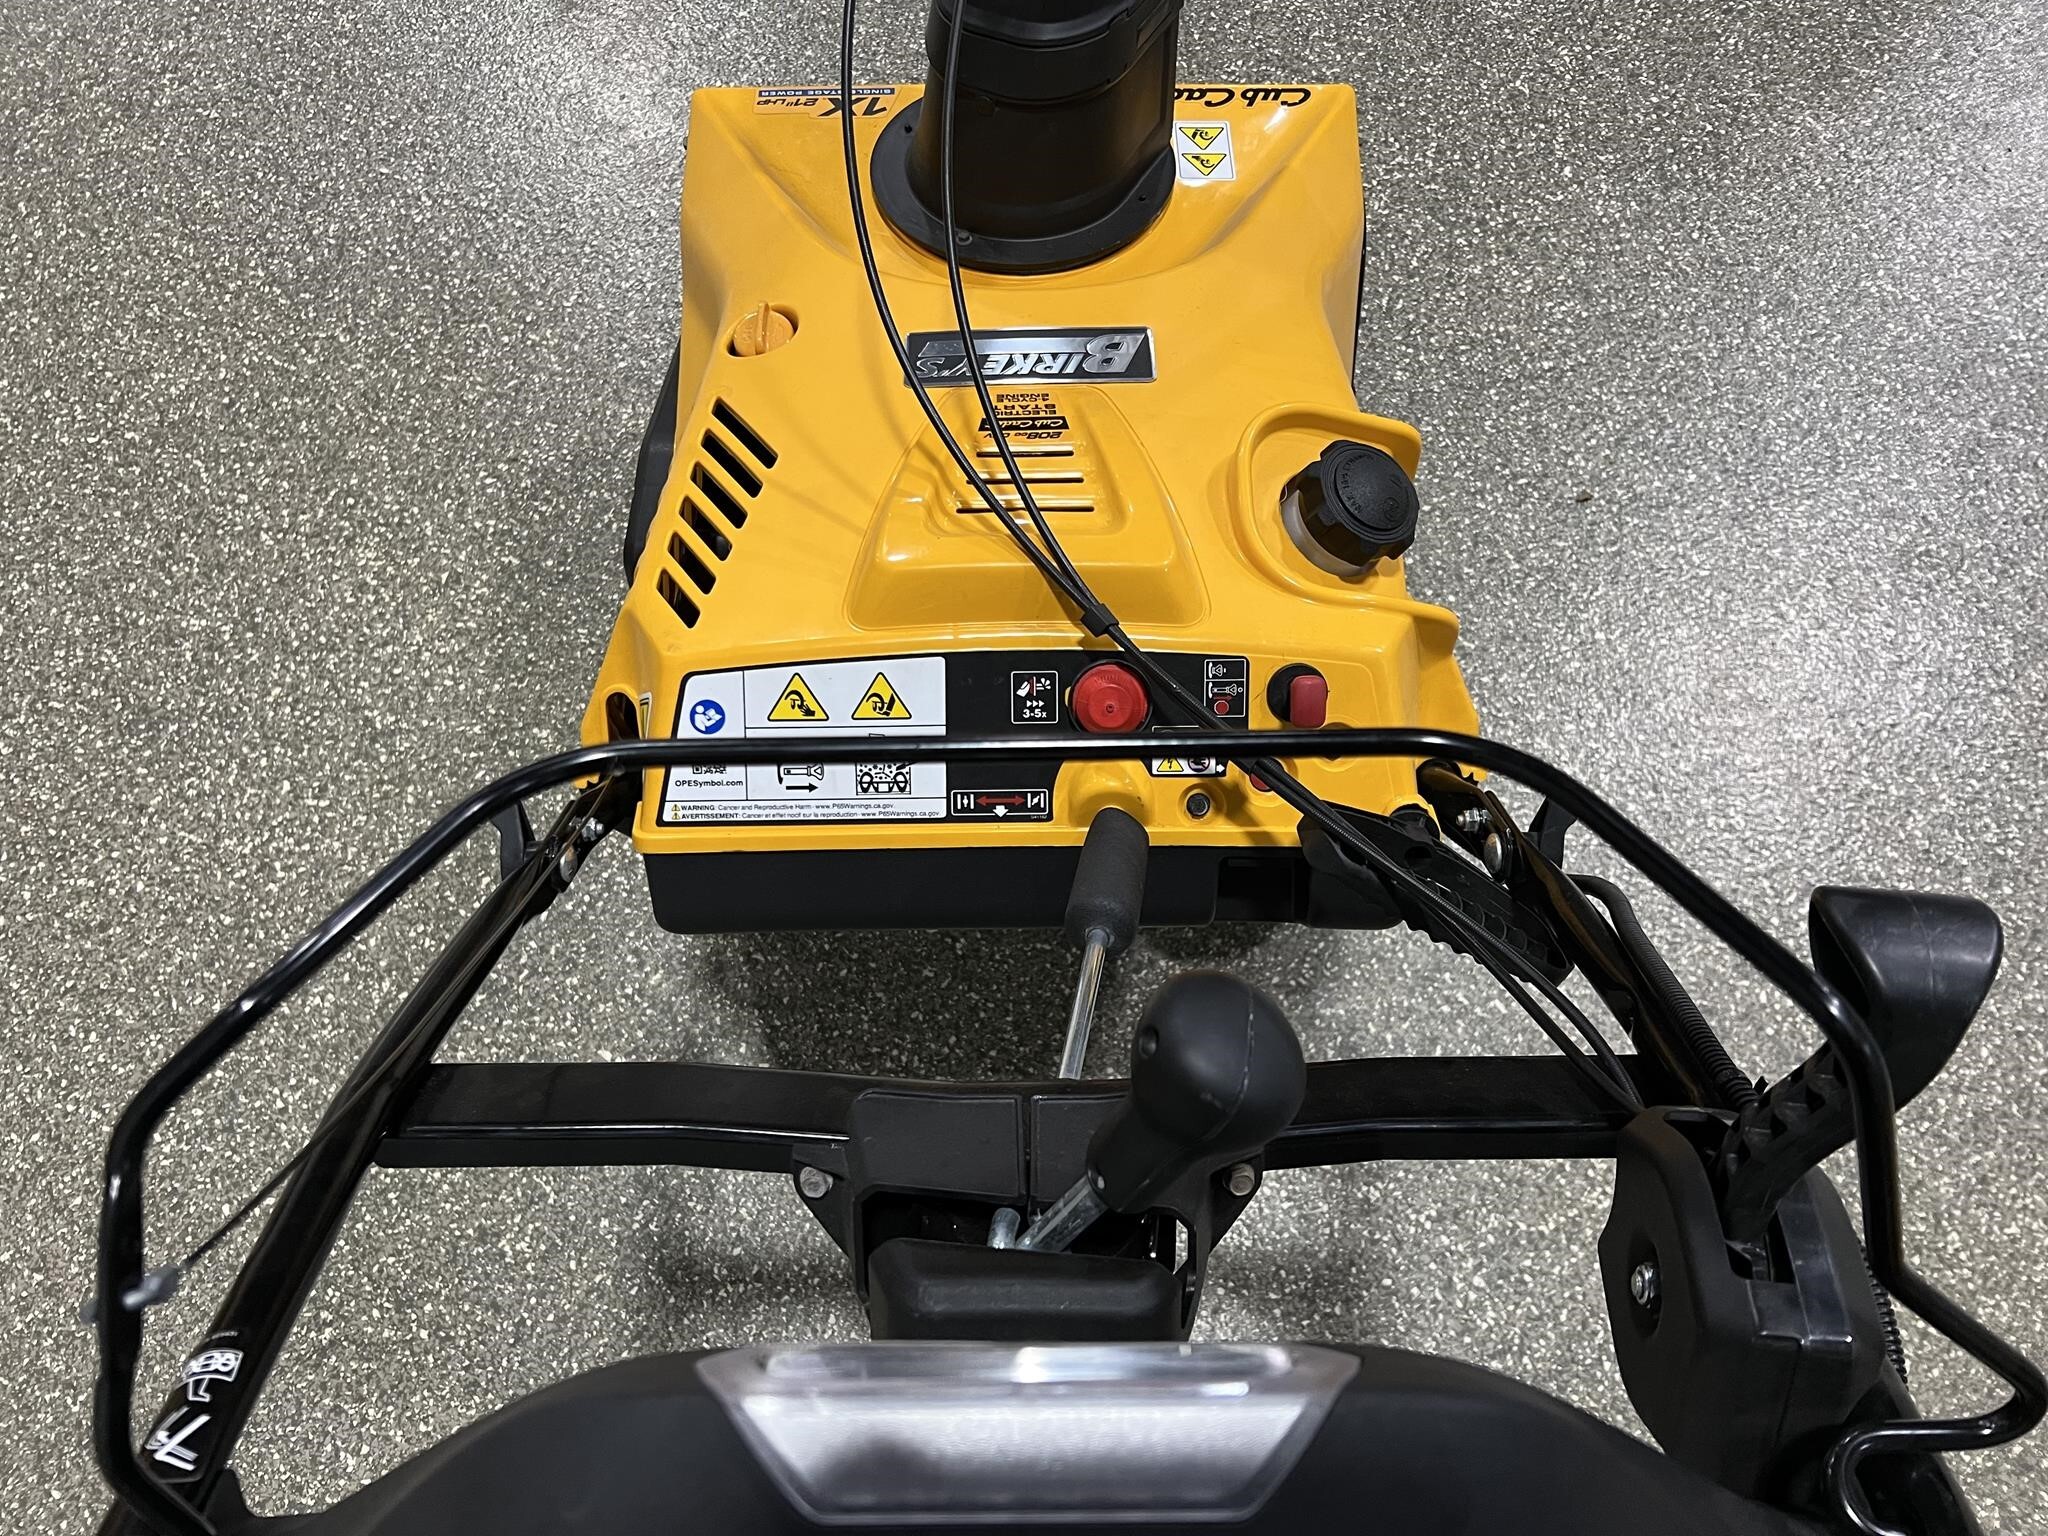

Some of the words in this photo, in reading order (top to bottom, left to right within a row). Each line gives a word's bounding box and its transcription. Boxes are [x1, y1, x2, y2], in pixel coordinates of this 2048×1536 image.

[756, 98, 787, 106] LHP
[1240, 88, 1312, 107] Cub
[1034, 419, 1063, 428] Cub
[1022, 709, 1047, 719] 3-5x
[675, 780, 744, 788] OPESymbol.com
